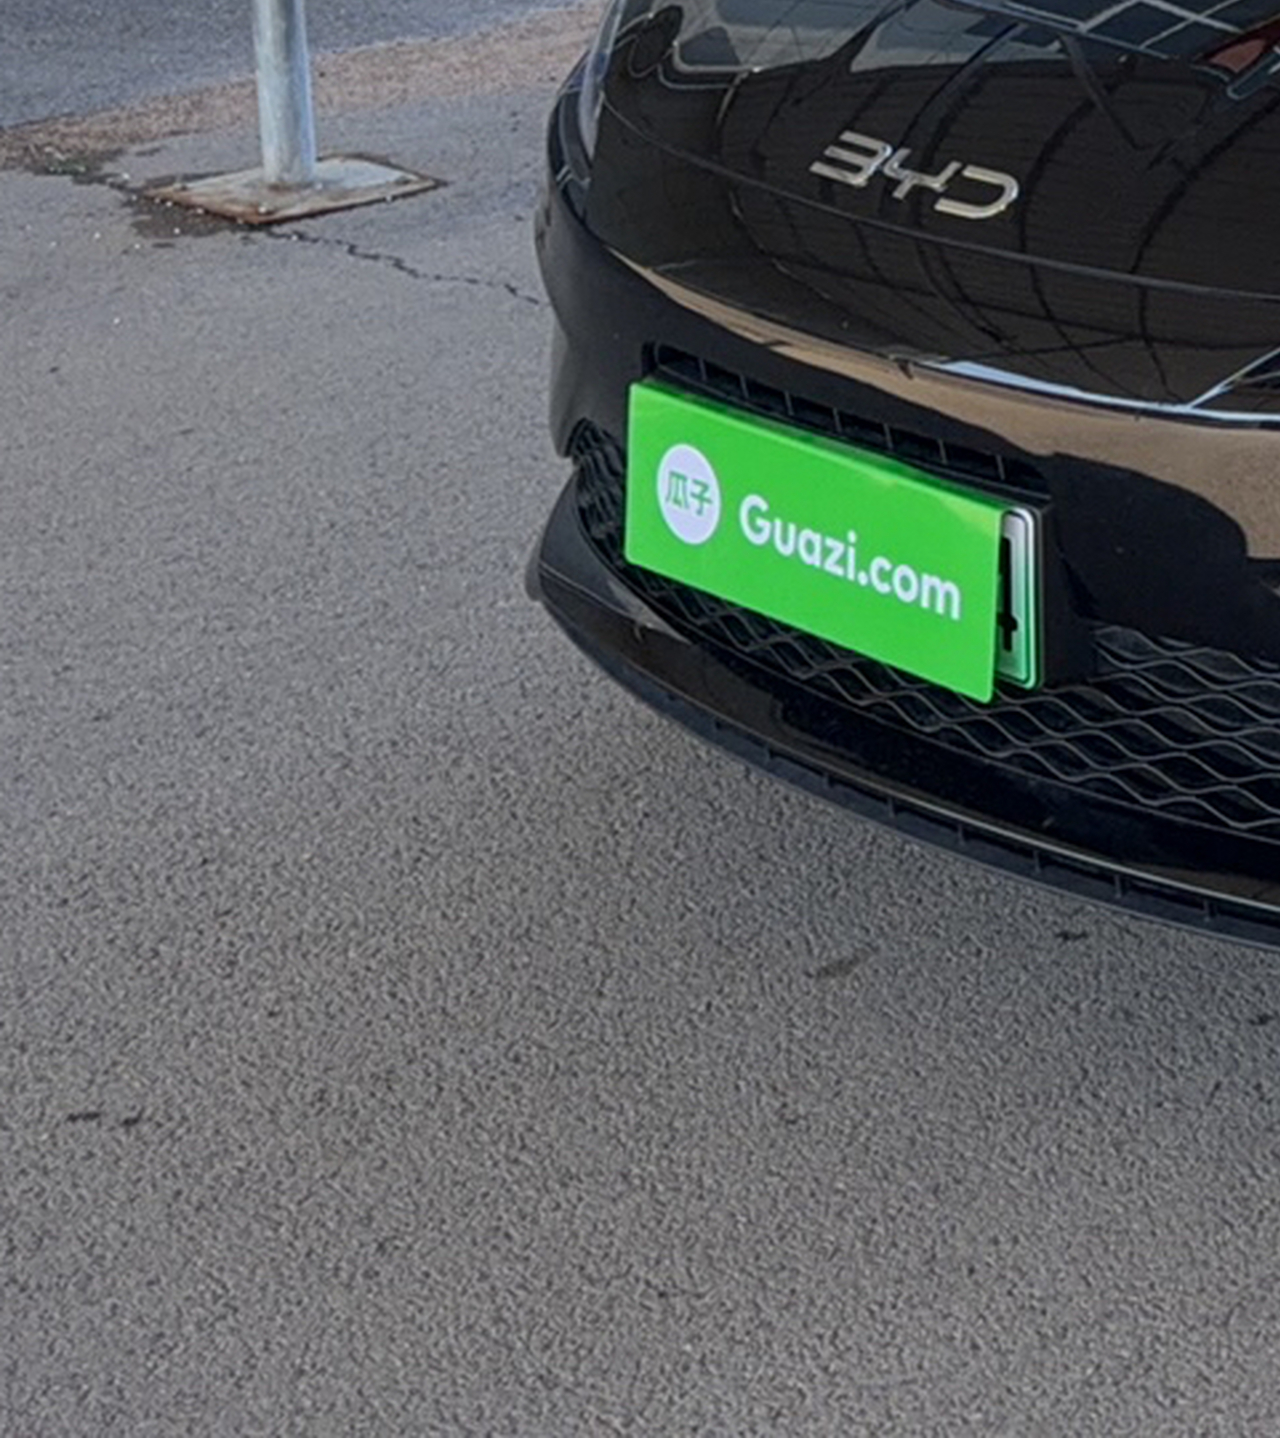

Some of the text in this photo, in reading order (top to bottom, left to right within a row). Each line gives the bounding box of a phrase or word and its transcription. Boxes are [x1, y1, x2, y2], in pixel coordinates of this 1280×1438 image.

[811, 130, 1020, 219] BYD
[664, 471, 714, 517] 瓜子
[738, 495, 961, 620] Guazi.com
